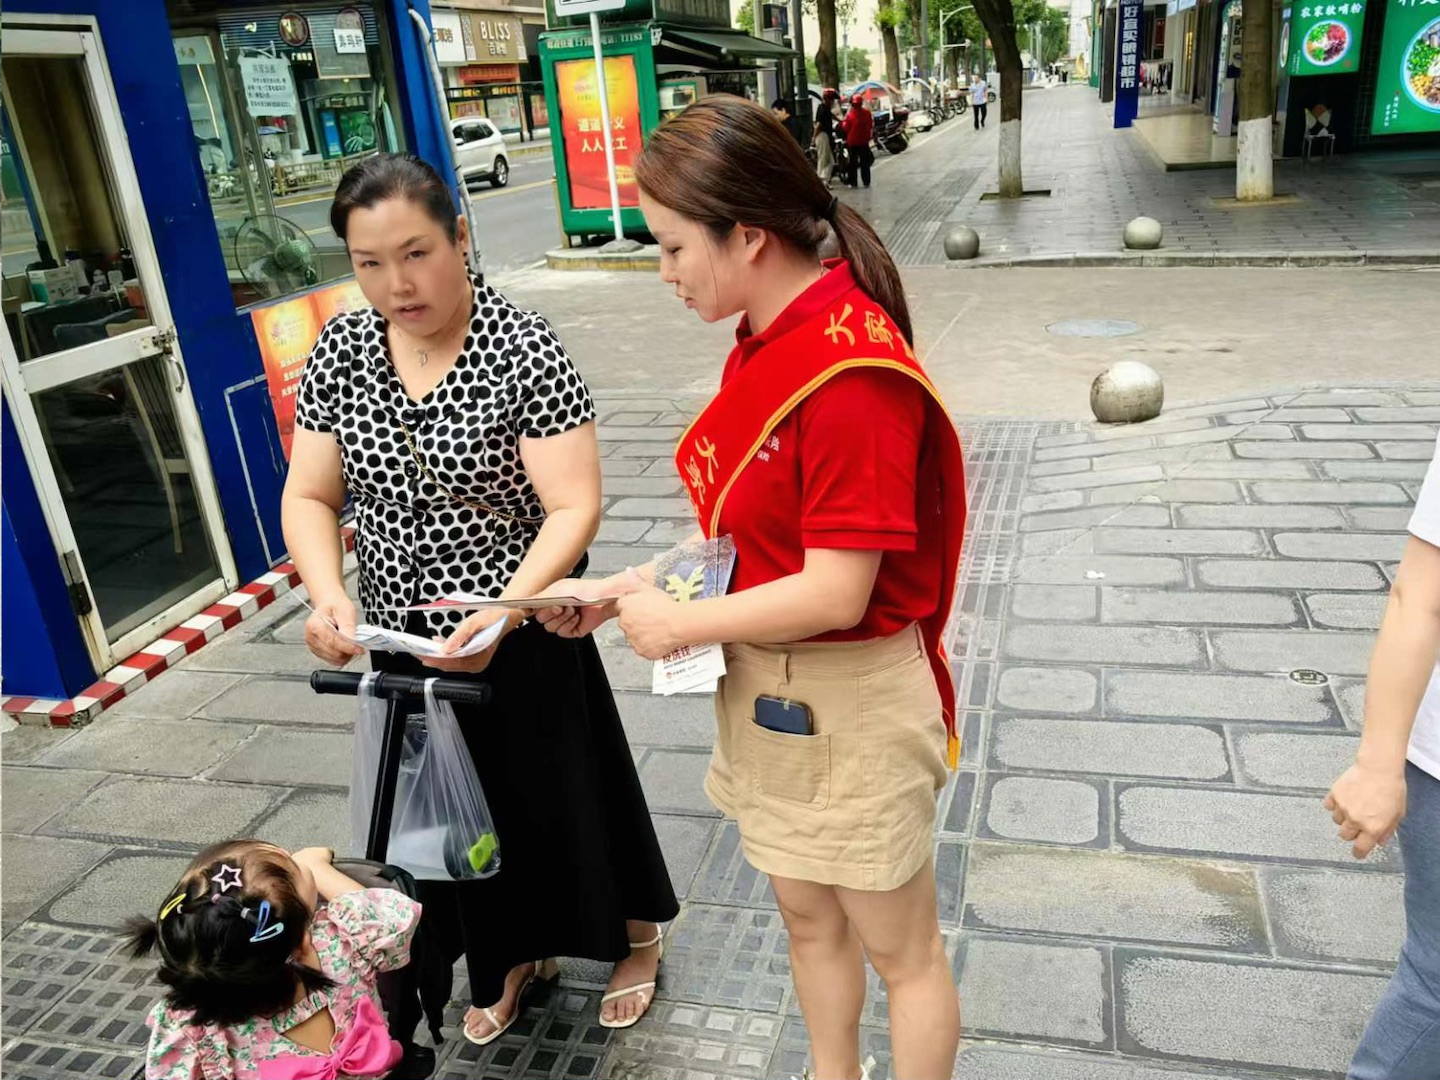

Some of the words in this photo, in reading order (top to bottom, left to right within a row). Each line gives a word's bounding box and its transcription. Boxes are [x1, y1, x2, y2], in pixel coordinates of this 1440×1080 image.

[480, 21, 511, 40] BLISS
[581, 137, 628, 153] 人人工
